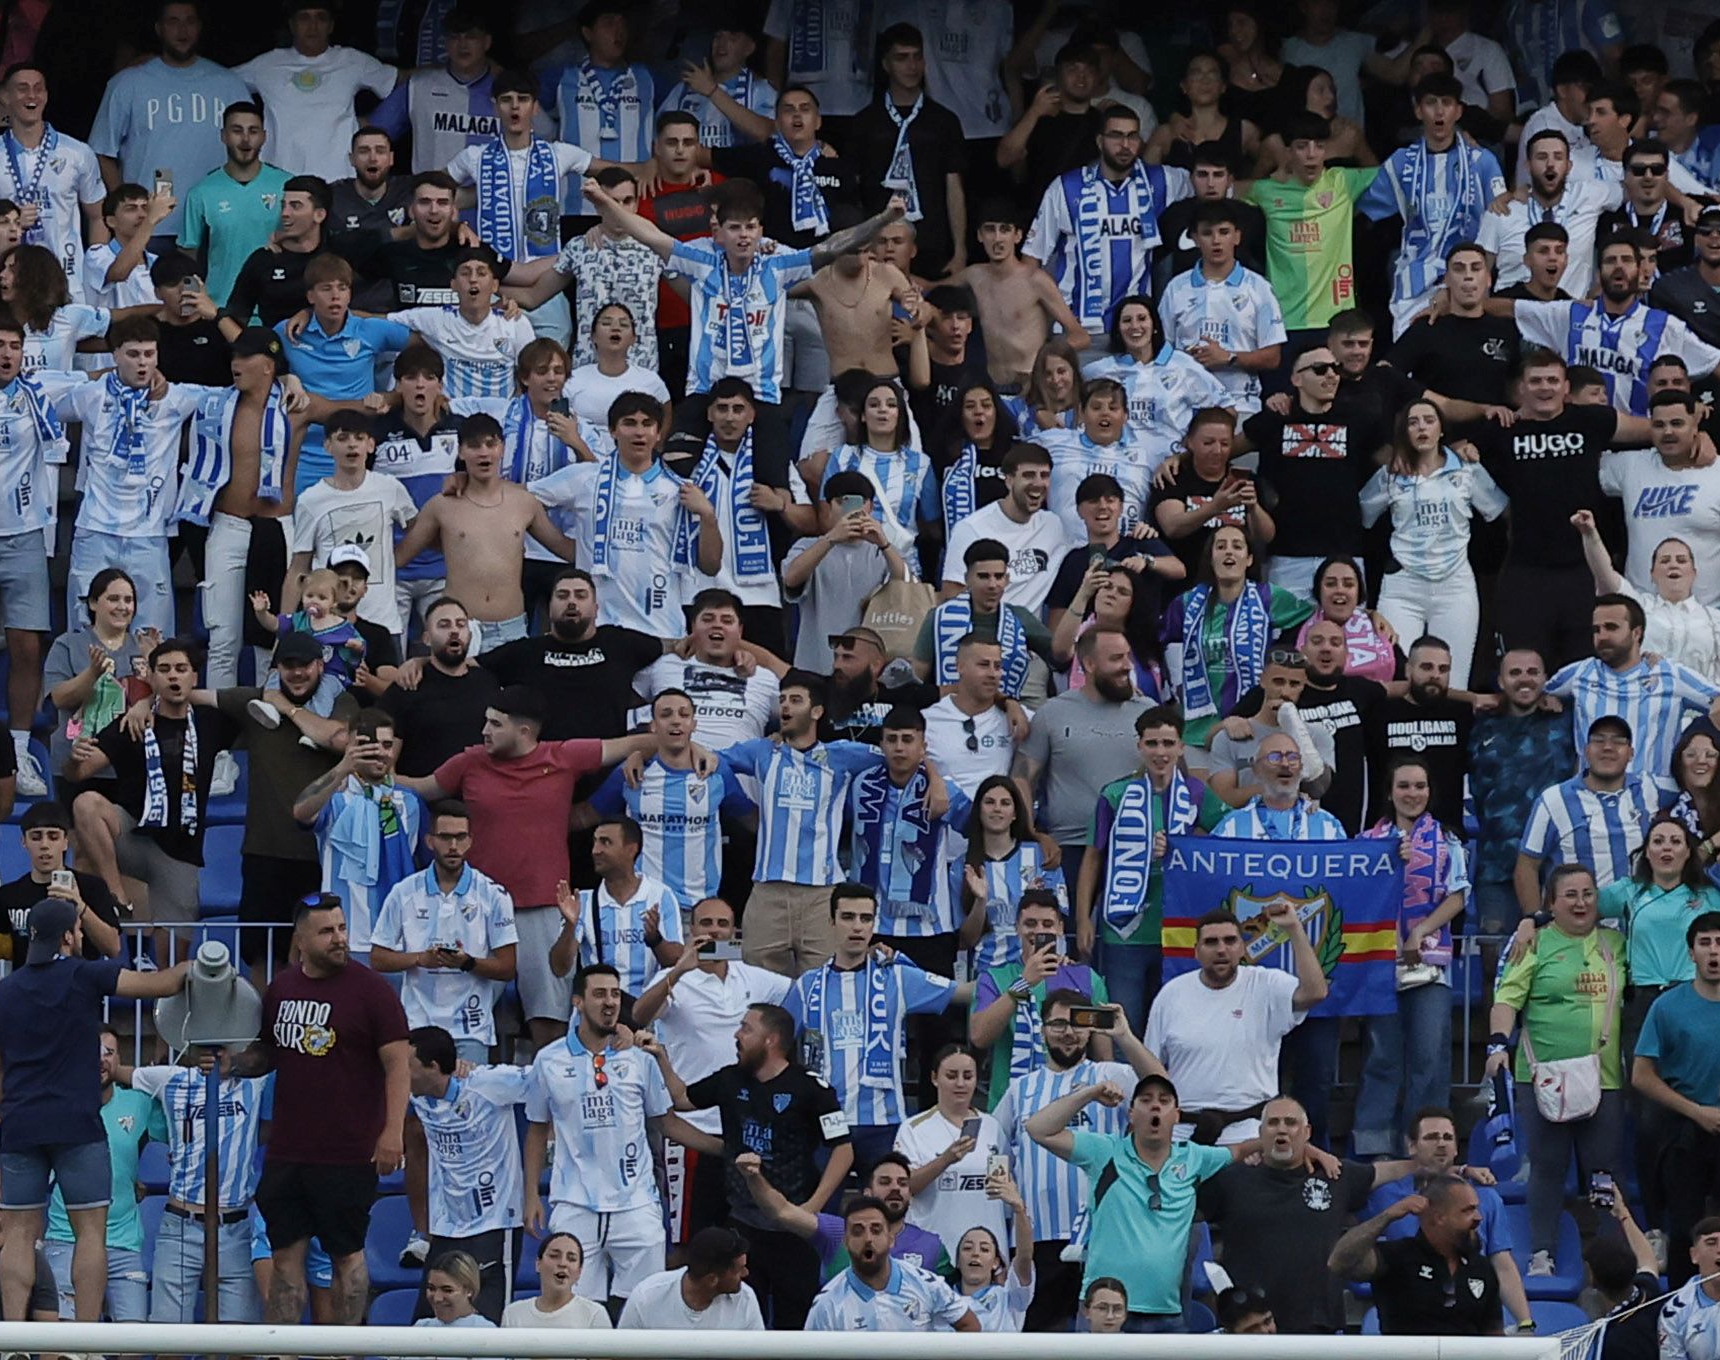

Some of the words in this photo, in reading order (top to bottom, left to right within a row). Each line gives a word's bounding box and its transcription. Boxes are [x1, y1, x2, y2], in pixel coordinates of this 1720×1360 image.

[417, 287, 460, 304] TESES
[386, 442, 411, 464] 04
[1514, 432, 1585, 455] HUGO
[19, 471, 31, 508] Olin
[1633, 484, 1701, 519] NIKE
[652, 574, 668, 610] Olin
[1387, 720, 1457, 736] HOOLIGANS
[636, 813, 711, 827] MARATHON
[1167, 850, 1396, 879] ANTEQUERA
[279, 1000, 332, 1027] FONDO
[468, 994, 482, 1029] Olin
[273, 1024, 306, 1054] SUR
[624, 1142, 638, 1179] Olin
[478, 1171, 495, 1208] Olin
